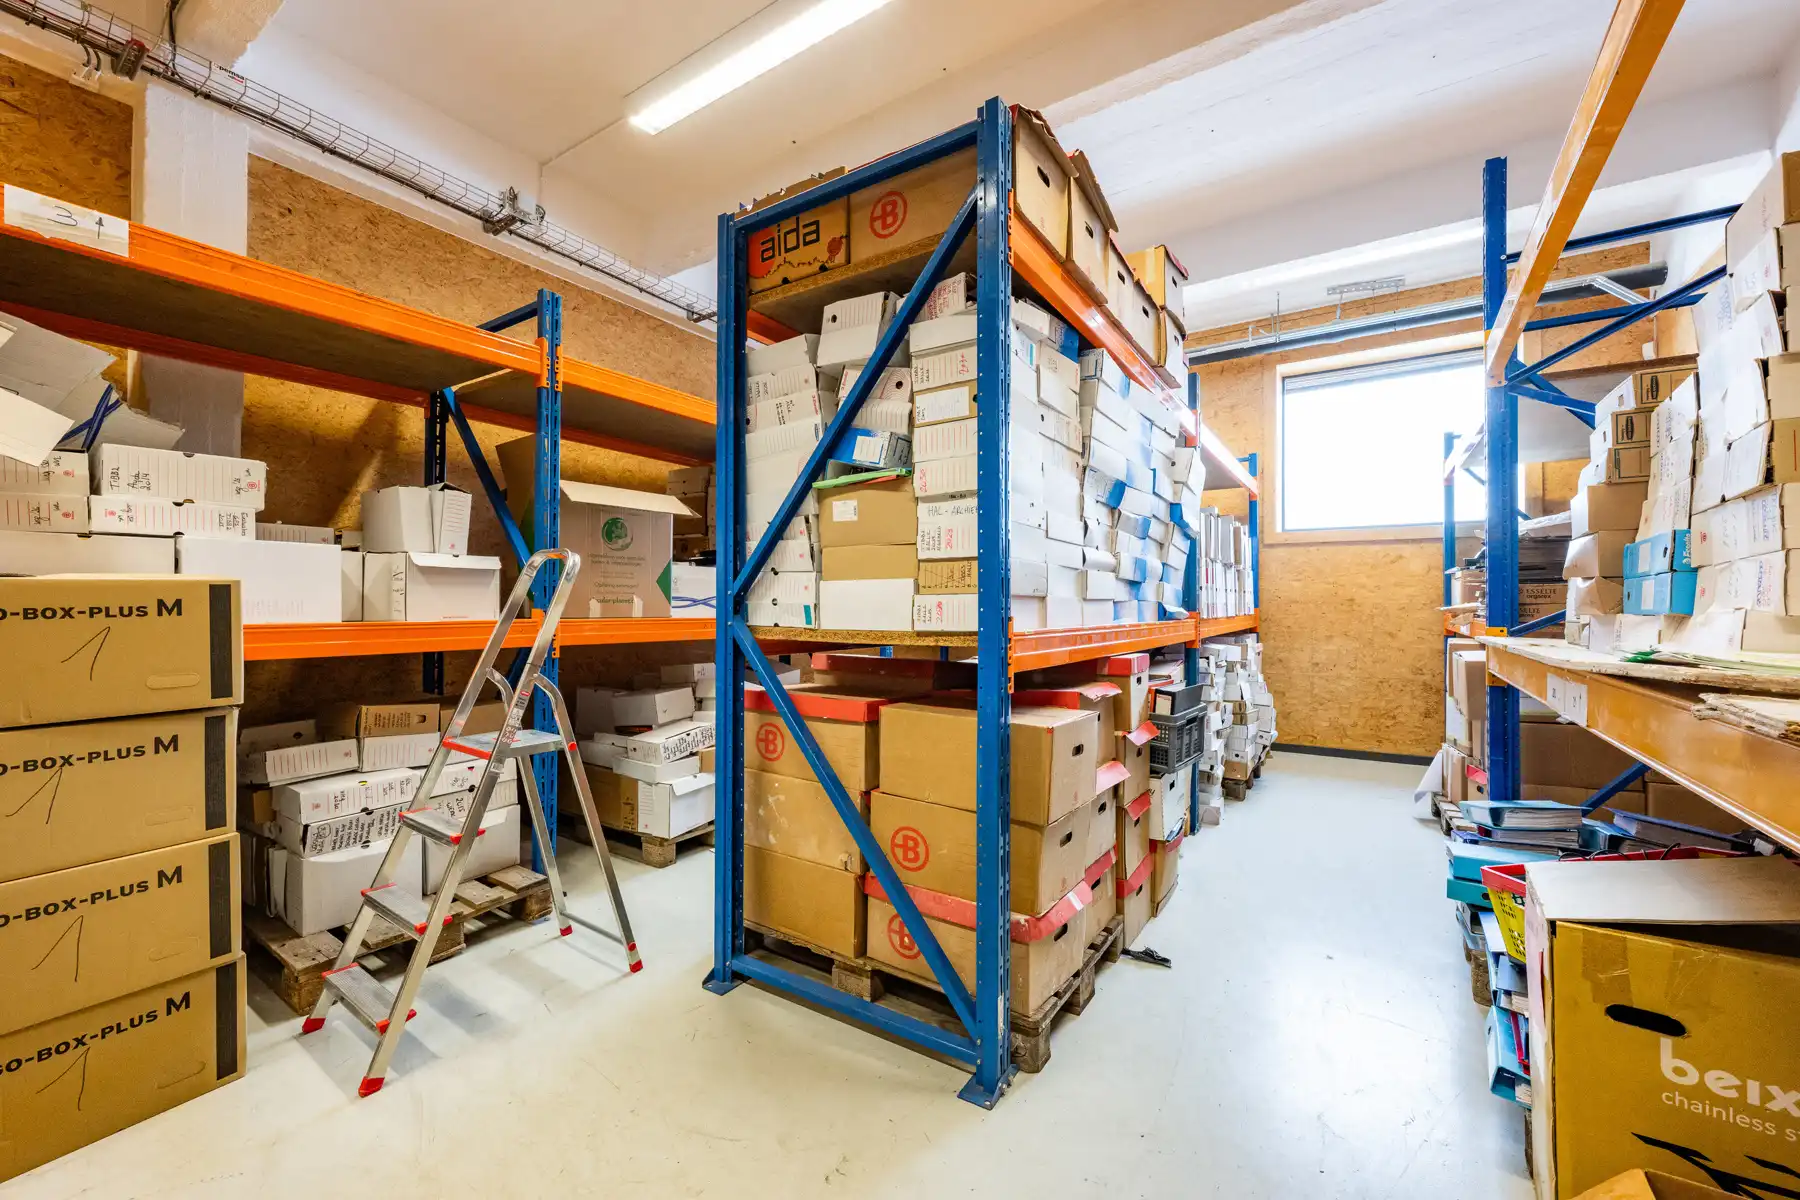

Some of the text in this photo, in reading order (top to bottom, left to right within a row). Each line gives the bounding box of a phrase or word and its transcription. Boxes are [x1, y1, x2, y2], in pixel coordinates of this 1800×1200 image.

[759, 216, 820, 263] aida
[156, 598, 183, 617] M
[154, 734, 179, 755] M
[157, 865, 183, 889] M
[0, 990, 191, 1076] O-BOX-PLUS M
[1661, 1091, 1776, 1136] chainless
